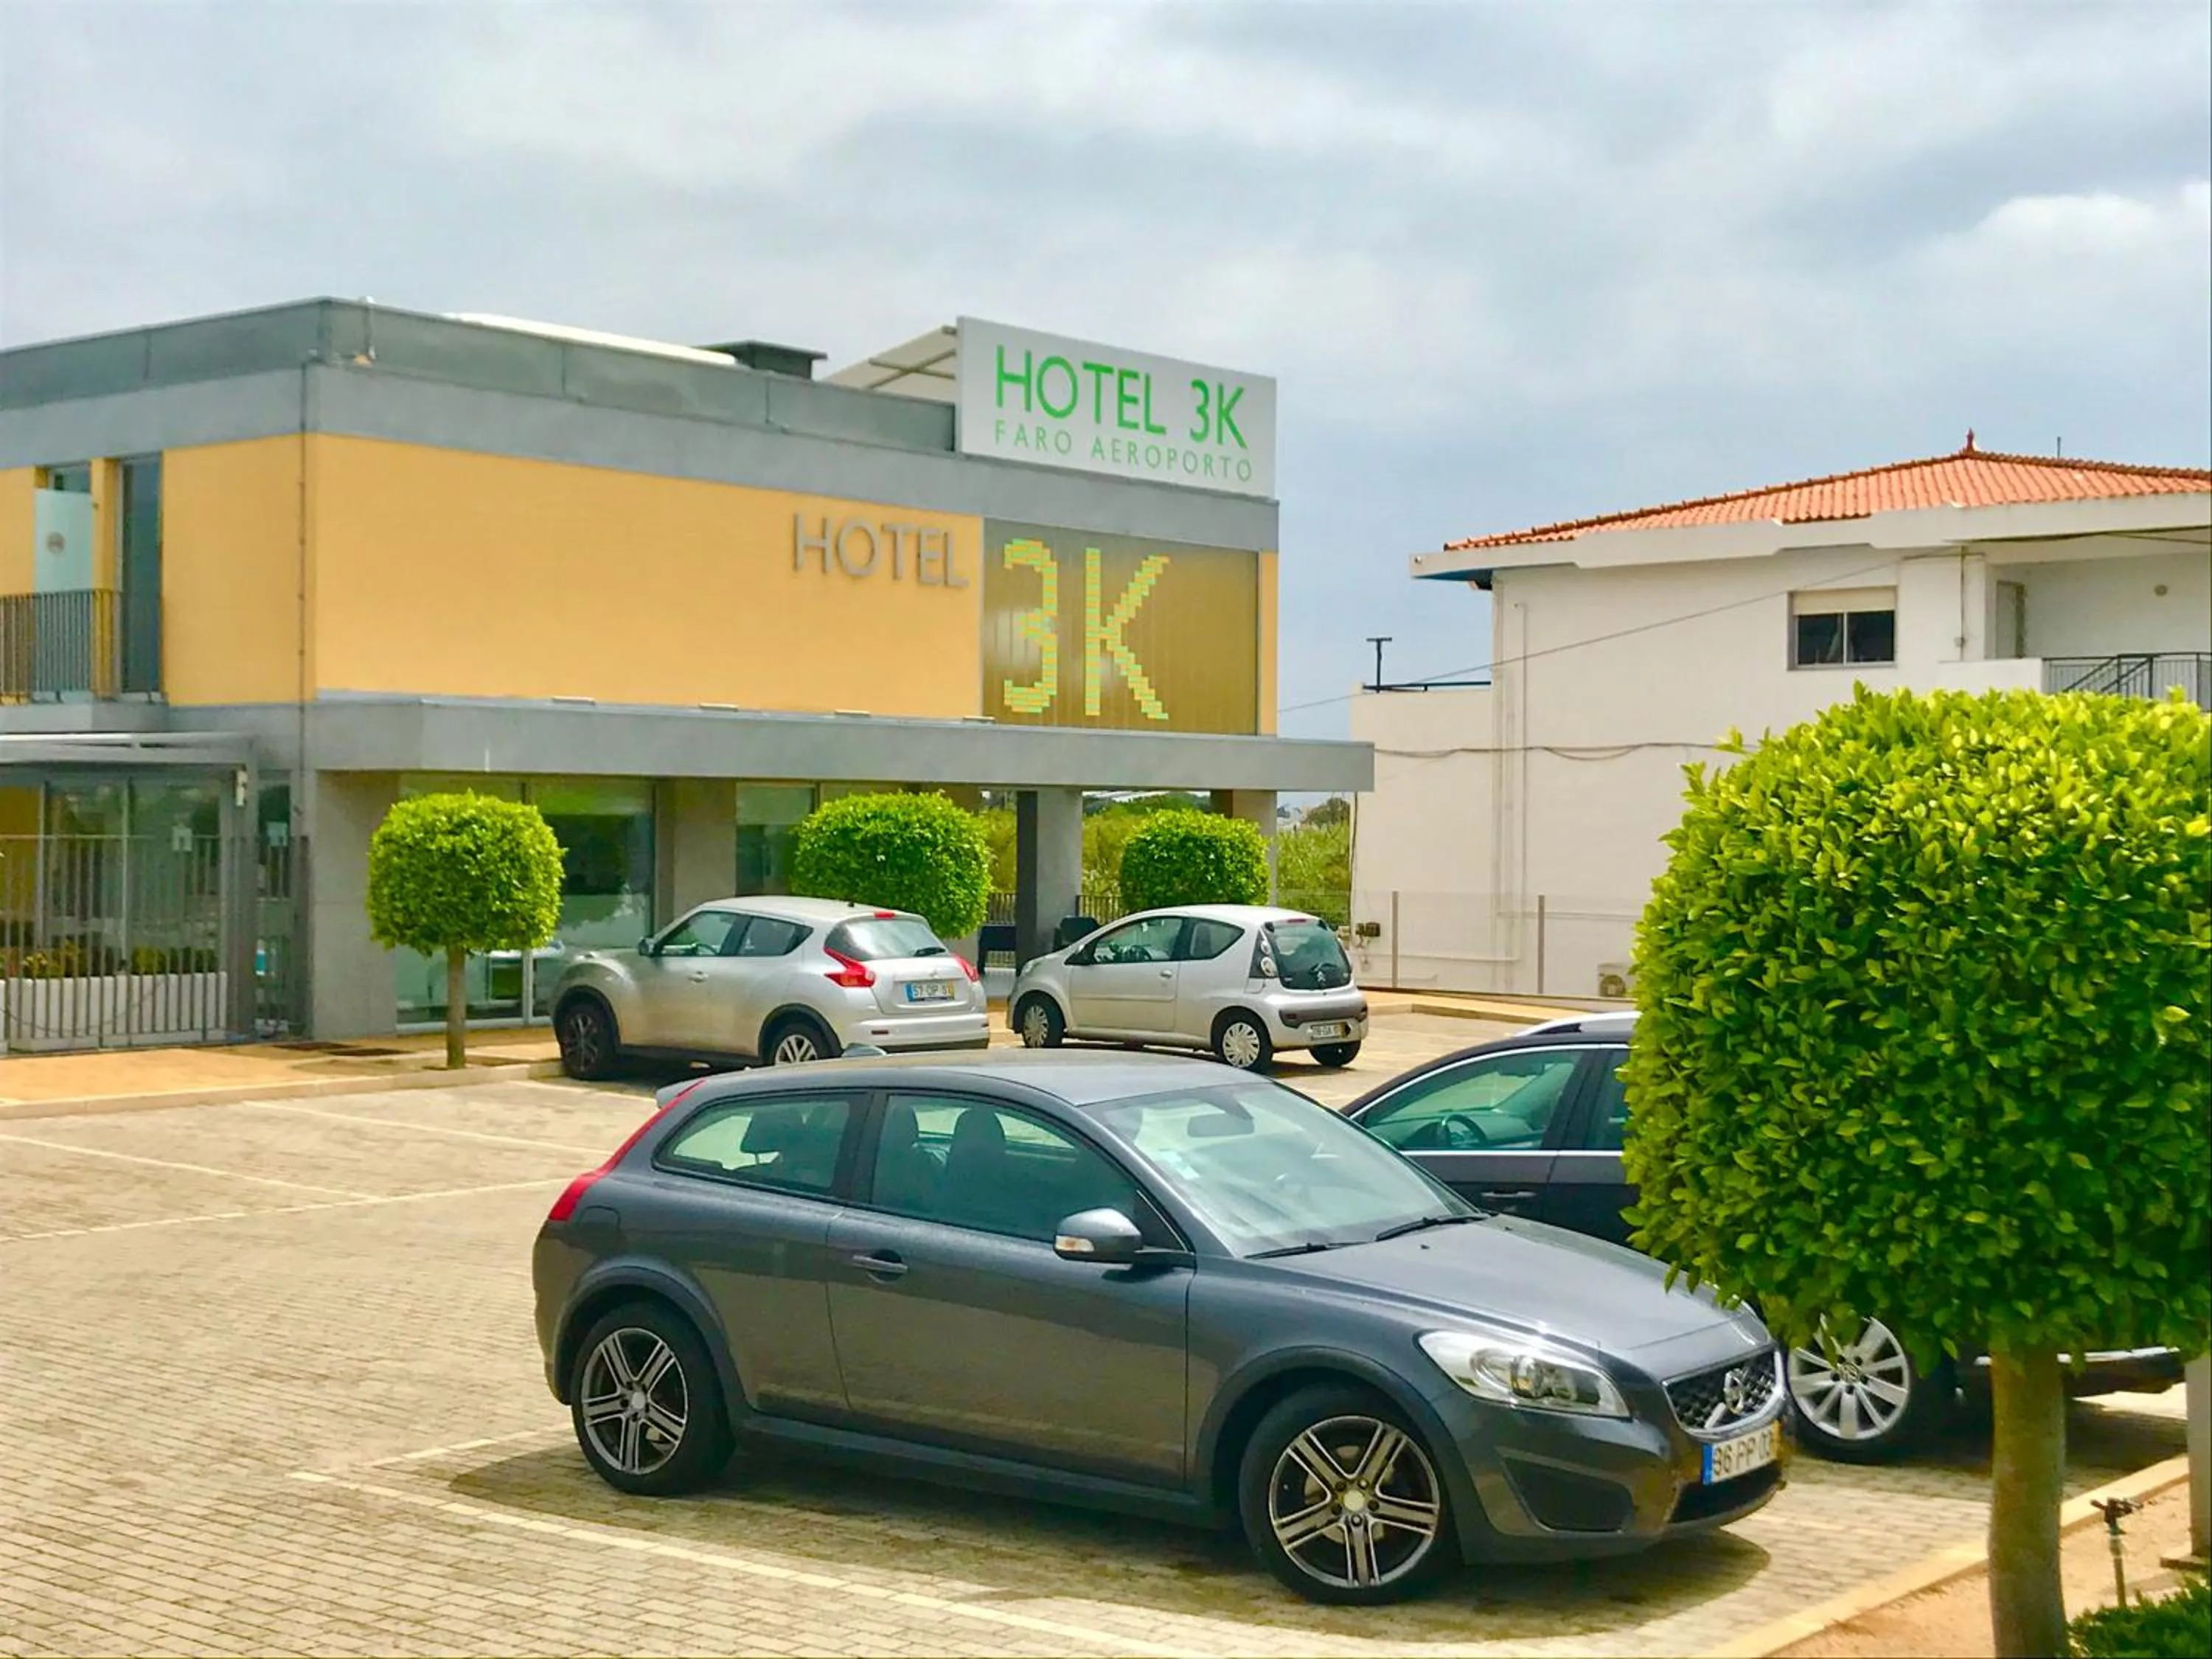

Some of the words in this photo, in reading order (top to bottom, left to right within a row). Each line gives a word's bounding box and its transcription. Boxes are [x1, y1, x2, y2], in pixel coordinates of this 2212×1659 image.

[995, 344, 1166, 435] HOTEL
[1189, 379, 1248, 449] 3K
[994, 420, 1072, 455] FARO
[1091, 437, 1252, 482] AEROPORTO
[793, 513, 969, 588] HOTEL
